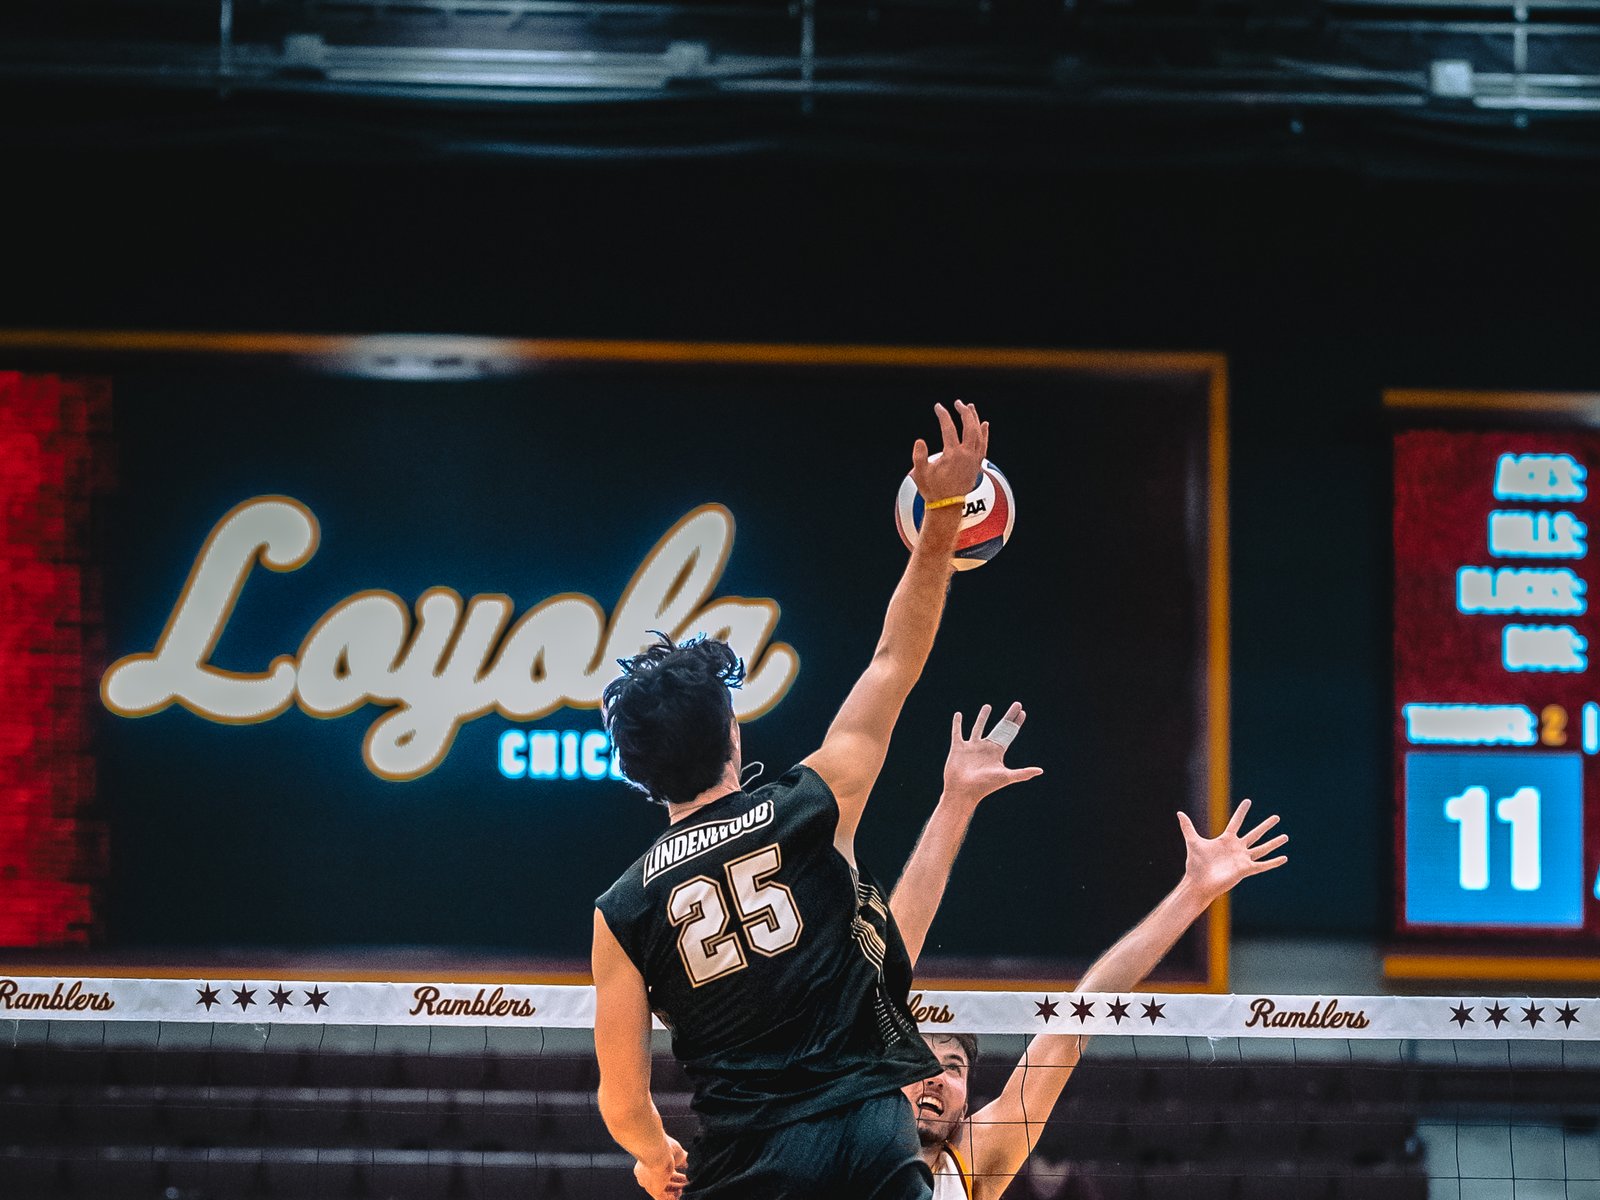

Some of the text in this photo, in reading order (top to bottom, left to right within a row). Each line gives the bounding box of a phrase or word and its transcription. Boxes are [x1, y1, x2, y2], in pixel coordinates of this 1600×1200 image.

[962, 498, 986, 518] AA
[100, 494, 800, 782] Loyola
[499, 729, 624, 781] CHIC
[1443, 785, 1542, 891] 11
[667, 842, 804, 989] 25
[0, 979, 115, 1012] Ramblers
[409, 985, 536, 1018] Ramblers
[908, 993, 955, 1024] lers
[1245, 998, 1370, 1030] Ramblers
